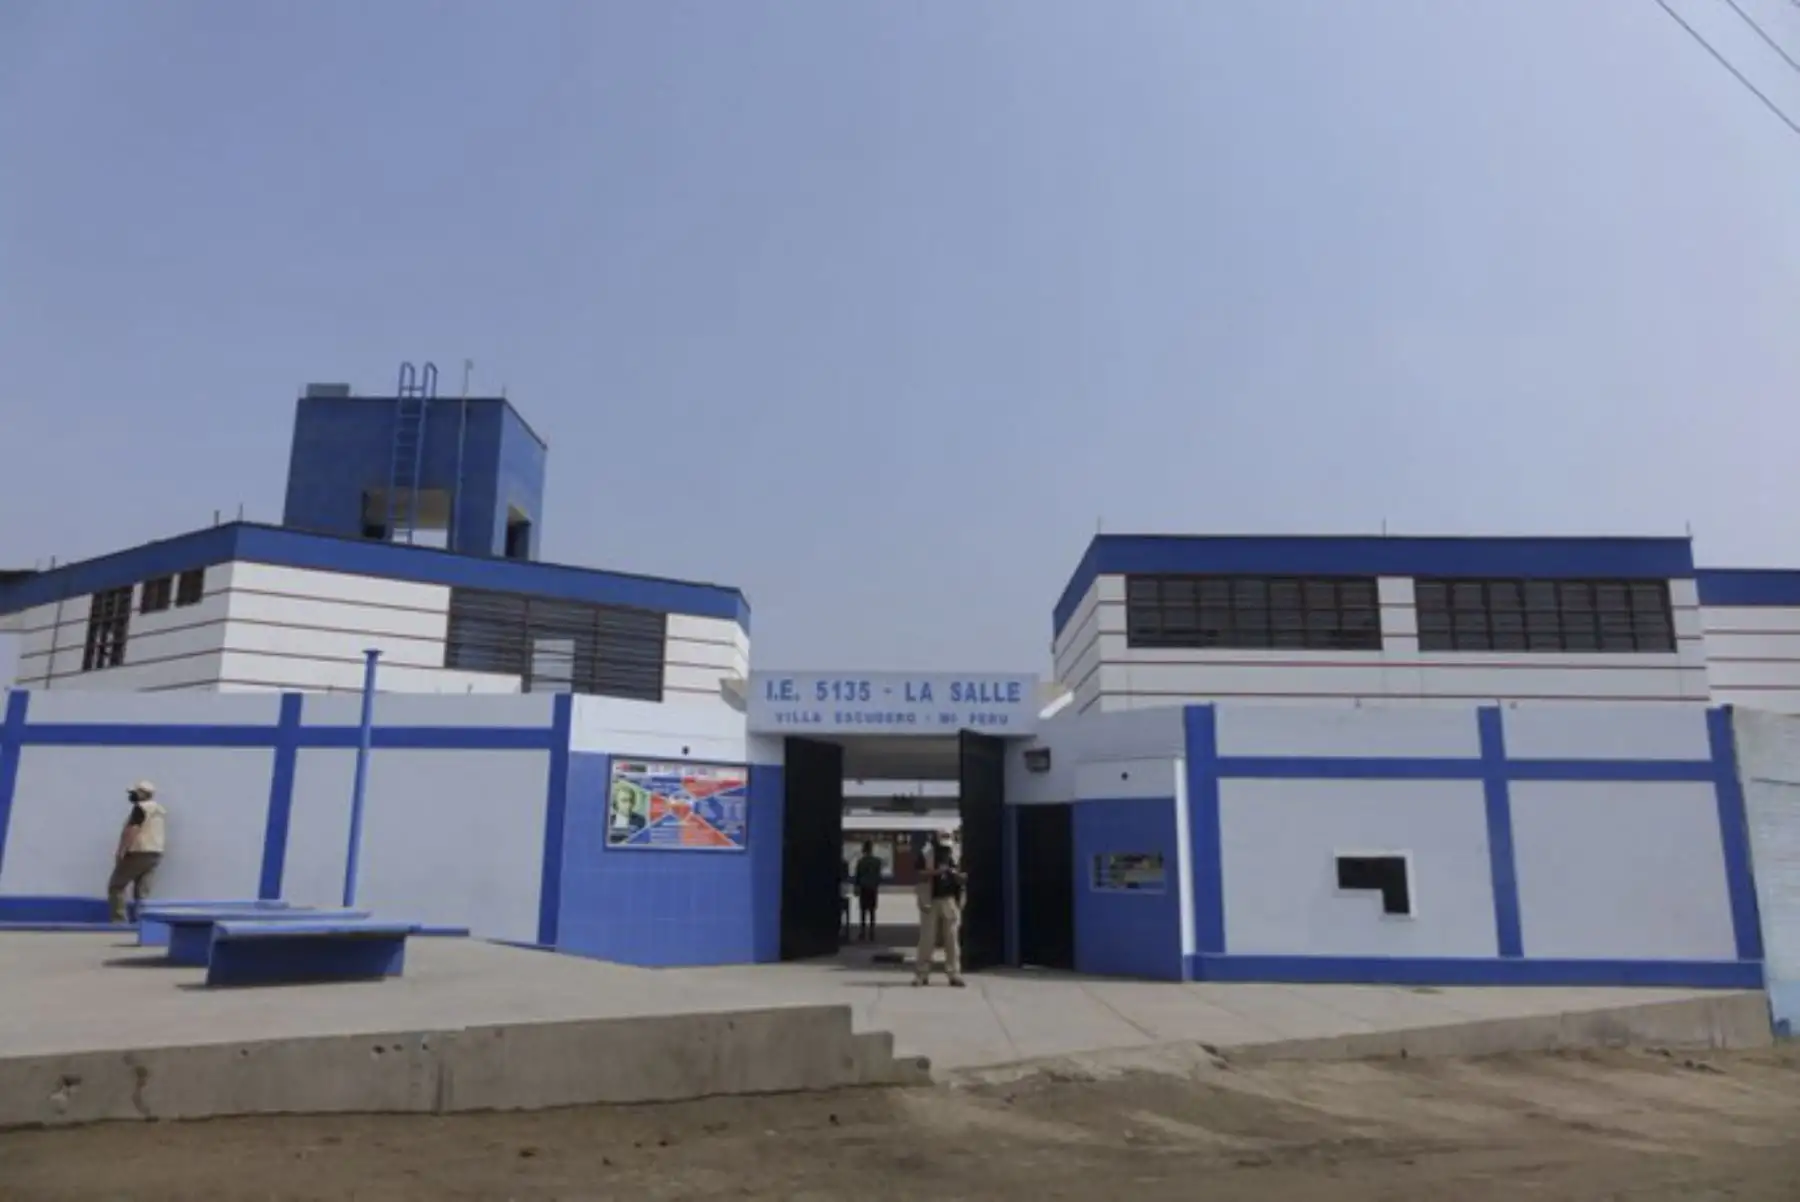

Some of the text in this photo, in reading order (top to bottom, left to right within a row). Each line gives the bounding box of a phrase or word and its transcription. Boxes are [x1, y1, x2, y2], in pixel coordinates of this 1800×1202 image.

[765, 679, 800, 702] I.E.
[815, 681, 872, 702] 5135
[905, 682, 935, 702] LA
[950, 682, 1022, 703] SALLE
[776, 711, 822, 724] VILLA
